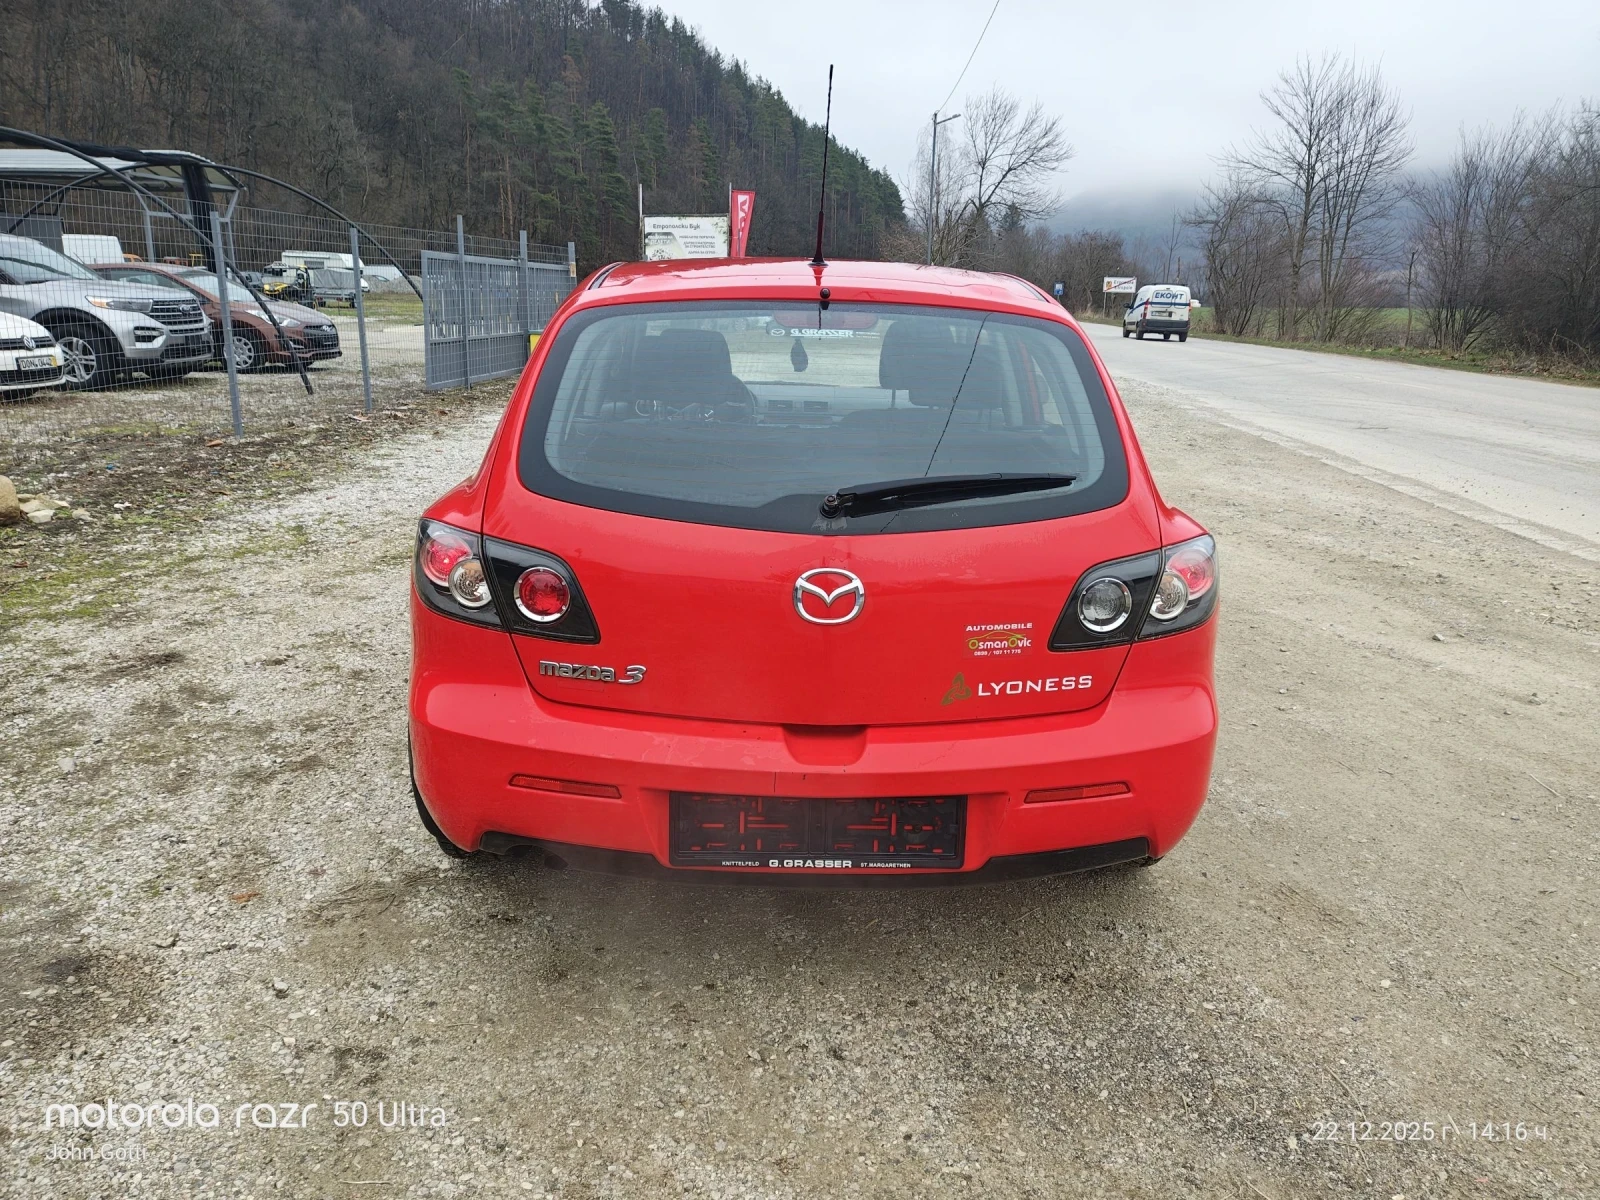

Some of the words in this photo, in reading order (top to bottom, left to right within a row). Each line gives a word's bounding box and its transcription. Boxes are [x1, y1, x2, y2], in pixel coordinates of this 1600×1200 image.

[966, 623, 1033, 631] AUTOMOBILE
[969, 637, 1032, 650] OsmanOvic
[618, 665, 646, 684] 3
[978, 675, 1093, 696] LYONESS
